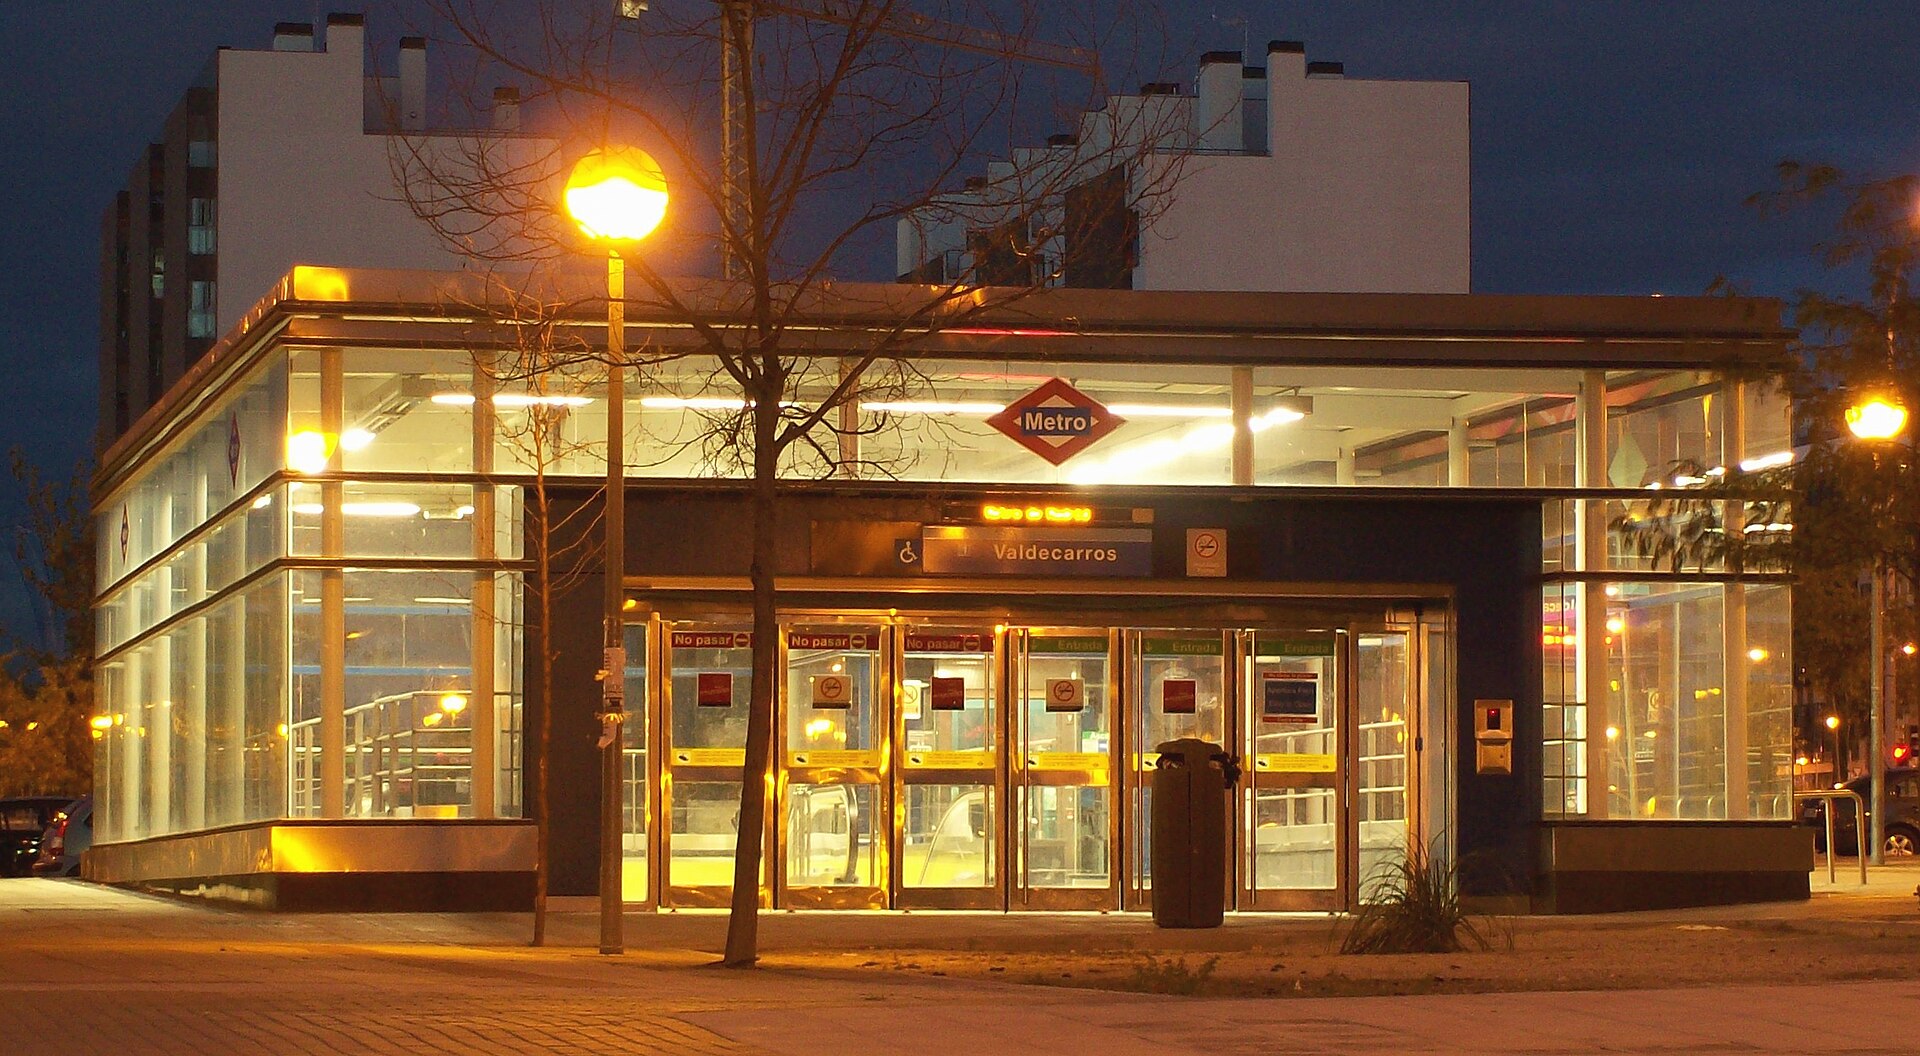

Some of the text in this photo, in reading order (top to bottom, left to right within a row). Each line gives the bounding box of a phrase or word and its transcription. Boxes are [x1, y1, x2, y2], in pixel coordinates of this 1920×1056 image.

[1025, 412, 1087, 431] Metro
[993, 544, 1117, 561] Valdecarros
[675, 634, 731, 646] No pasar
[791, 636, 848, 648] No pasar
[906, 638, 960, 650] No pasar
[1058, 640, 1103, 650] Entrada
[1173, 642, 1217, 653] Entrada
